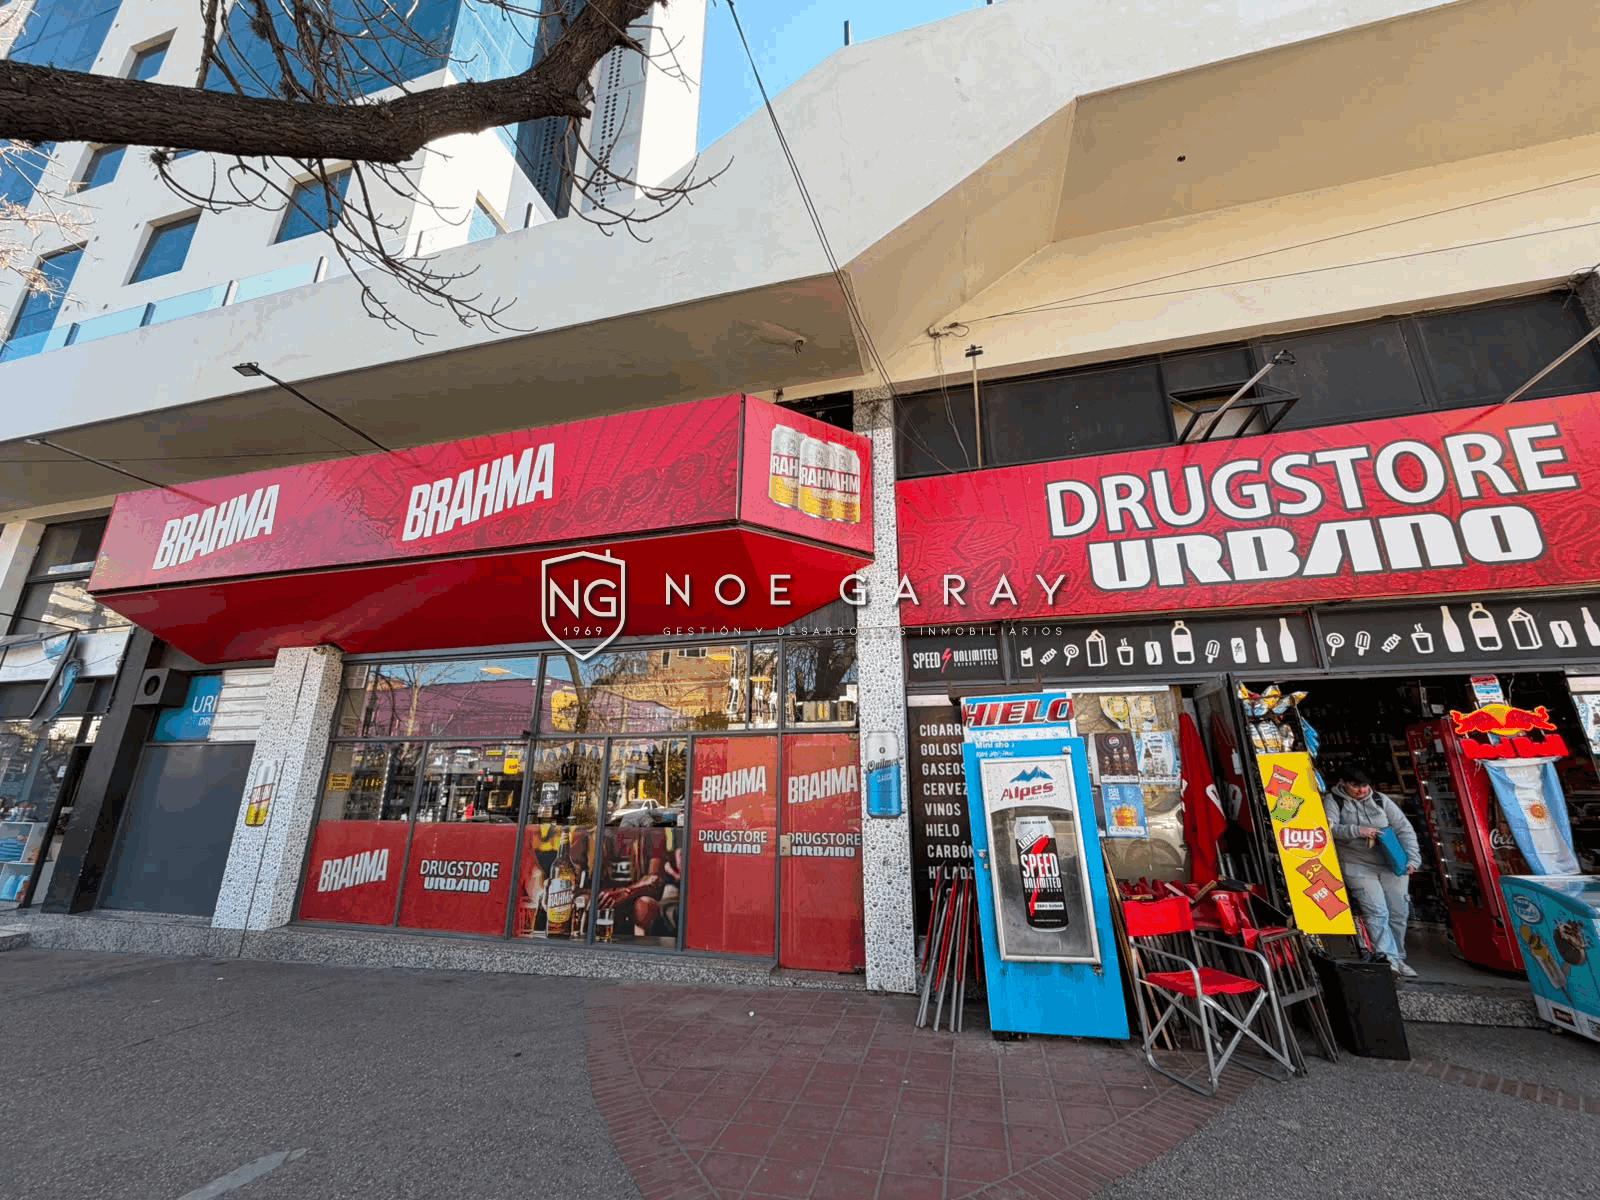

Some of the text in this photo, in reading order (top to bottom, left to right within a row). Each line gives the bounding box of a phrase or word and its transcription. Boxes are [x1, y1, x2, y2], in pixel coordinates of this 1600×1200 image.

[1046, 422, 1580, 539] DRUGSTORE
[401, 442, 556, 543] BRAHMA
[151, 483, 281, 571] BRAHMA
[1087, 503, 1547, 591] URBANO
[912, 648, 999, 670] SPEED UNLIMITED
[962, 698, 1075, 728] HIELO
[700, 765, 768, 803] BRAHMA
[787, 765, 859, 804] BRAHMA
[1000, 782, 1054, 801] Alpes
[925, 803, 961, 816] VINOS
[698, 830, 769, 844] DRUGSTORE
[926, 824, 960, 837] HIELO
[1283, 828, 1326, 850] Lay's
[703, 842, 762, 855] URBANO
[791, 846, 856, 858] URBANO
[317, 848, 389, 893] BRAHMA
[419, 859, 500, 879] DRUGSTORE
[1021, 853, 1060, 878] SPEED
[423, 876, 491, 893] URBANO
[1023, 877, 1062, 889] UNLIMITED
